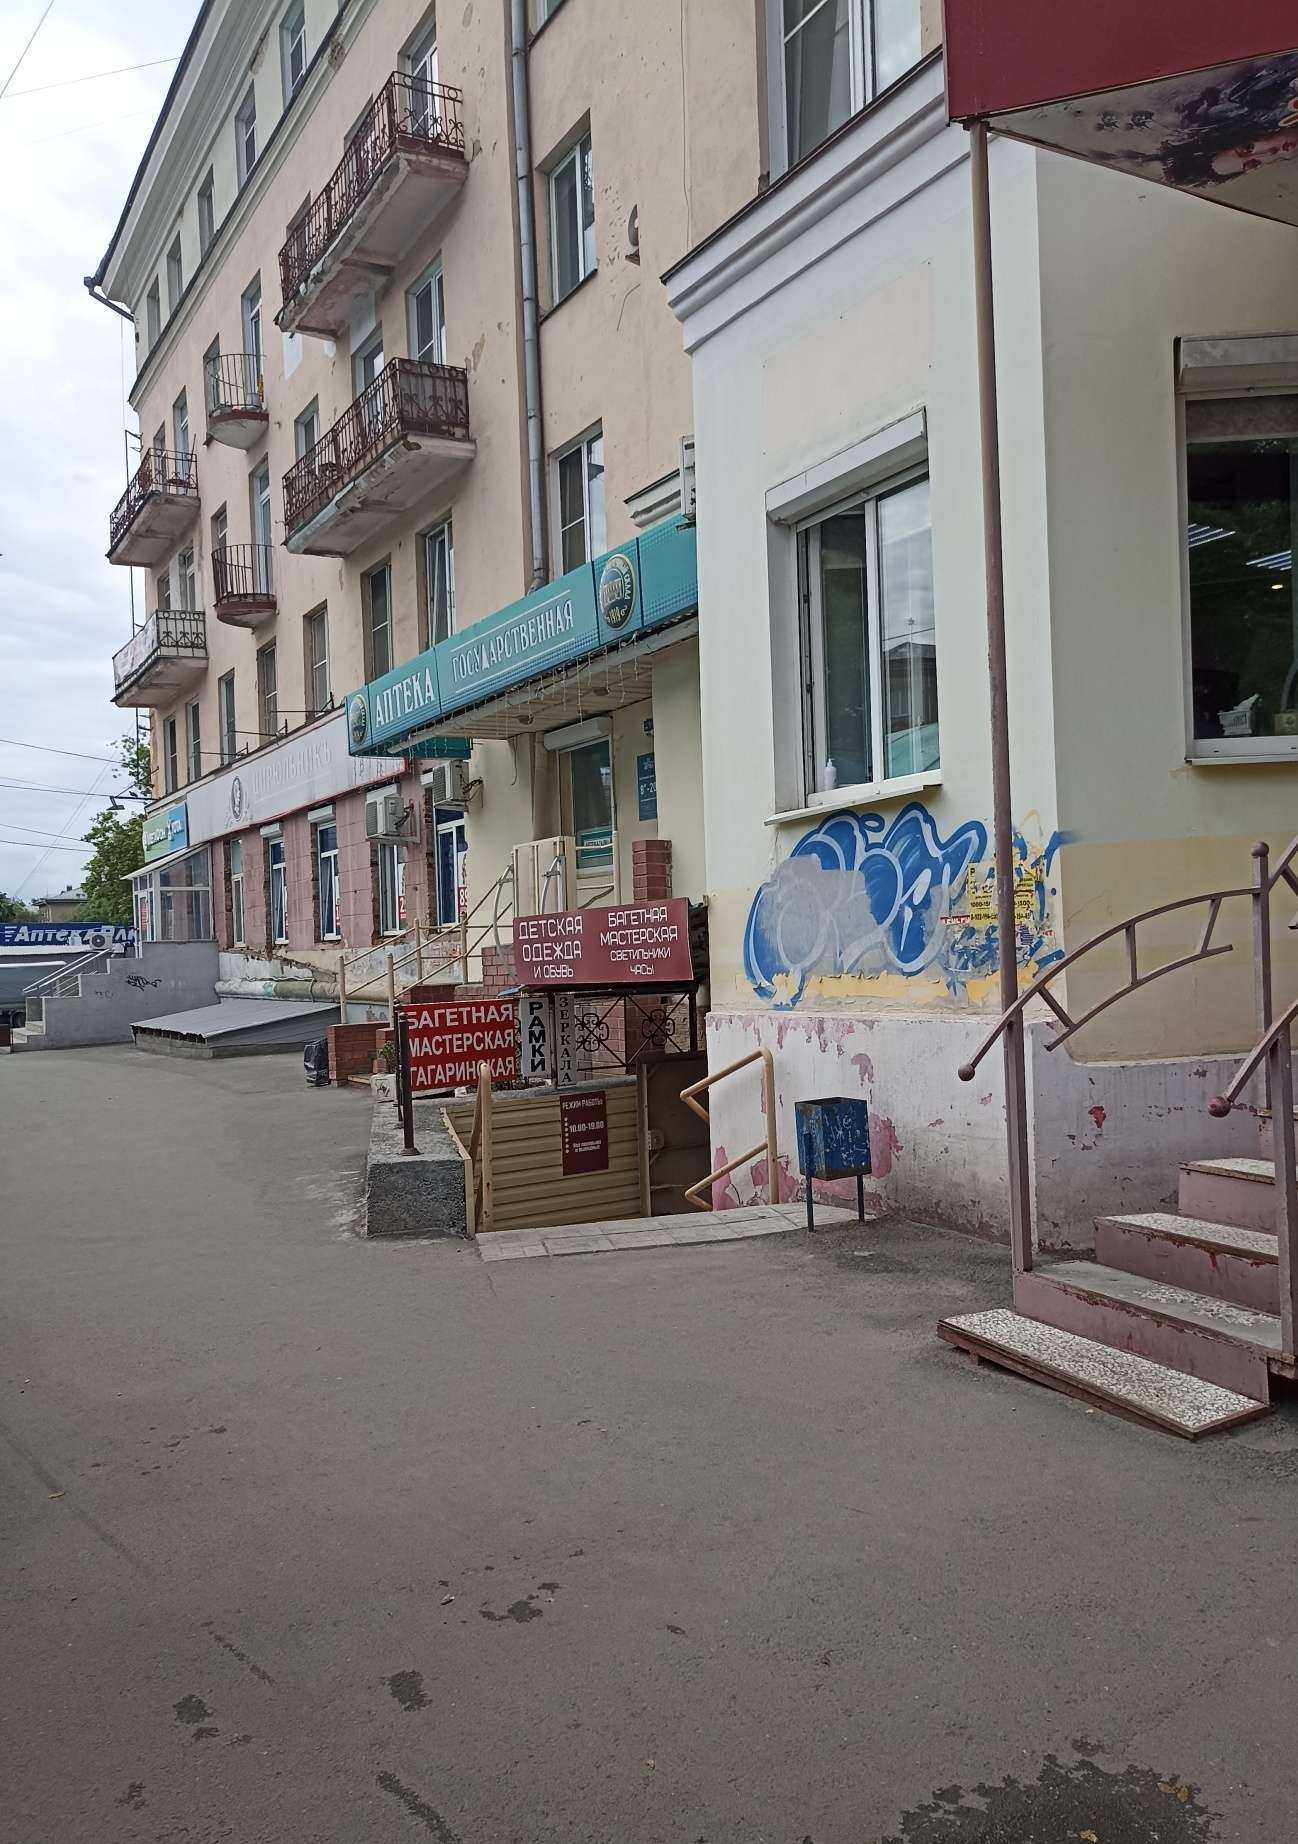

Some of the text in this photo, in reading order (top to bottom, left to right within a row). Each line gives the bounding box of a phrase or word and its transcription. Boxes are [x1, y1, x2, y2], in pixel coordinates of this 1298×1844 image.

[452, 599, 574, 682] ГОСУДАРСТВЕННАЯ
[375, 668, 435, 727] АПТЕКА
[608, 906, 667, 927] БАГЕТНАЯ
[518, 916, 583, 939] ДЕТСКАЯ
[600, 926, 678, 946] МАСТЕРСКАЯ
[522, 941, 582, 962] ОДЕЖДА
[610, 947, 671, 961] СВЕТИЛЬНИКИ
[534, 964, 574, 978] И ОБУВЬ
[630, 964, 654, 975] ЧАСЫ
[528, 1001, 546, 1072] РАМКИ
[560, 997, 572, 1082] ЗЕРКАЛА
